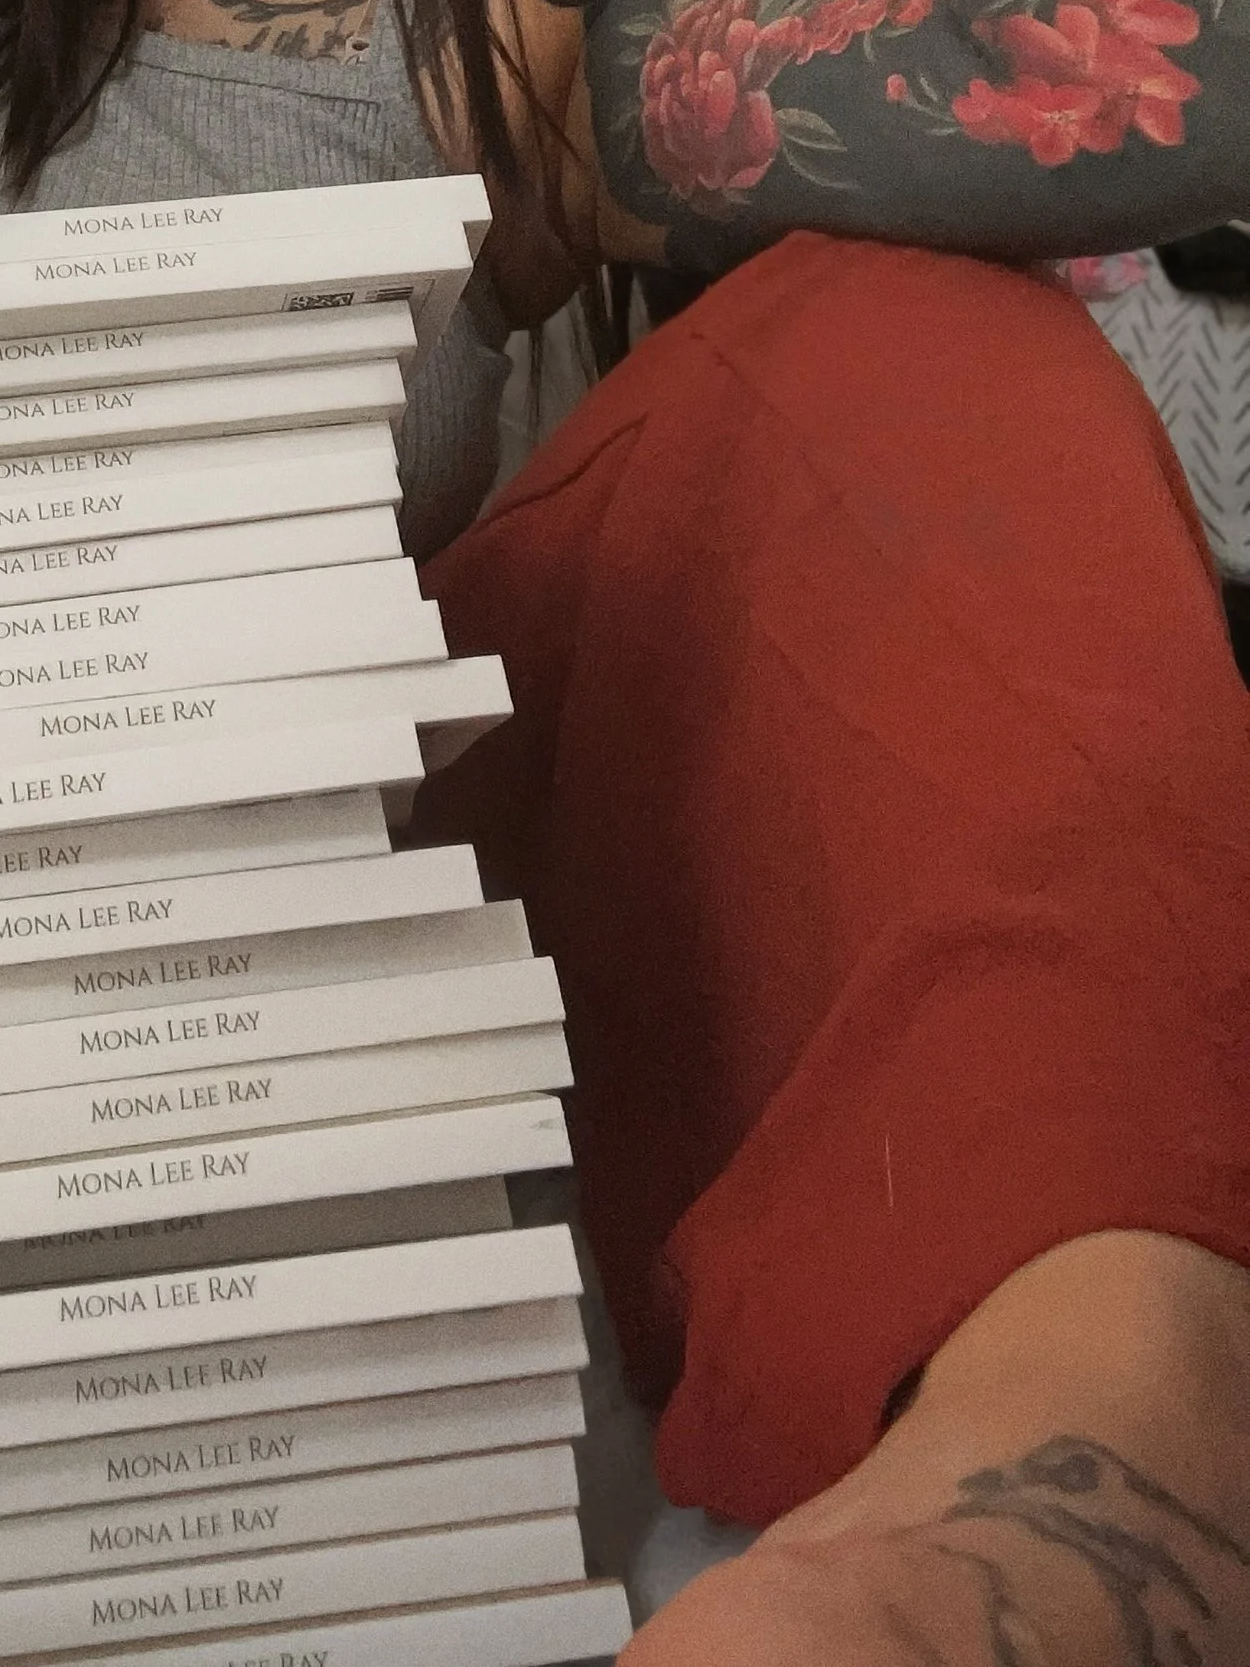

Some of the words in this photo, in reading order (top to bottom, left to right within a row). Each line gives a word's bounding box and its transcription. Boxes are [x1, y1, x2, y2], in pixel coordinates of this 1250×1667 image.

[65, 217, 134, 235] MONA
[141, 212, 177, 229] LEE
[184, 208, 222, 224] RAY
[36, 261, 106, 281] MONA
[113, 256, 150, 273] LEE
[157, 252, 196, 269] RAY
[62, 337, 98, 354] LEE
[105, 332, 143, 350] RAY
[52, 398, 88, 415] LEE
[95, 393, 134, 410] RAY
[51, 455, 86, 473] LEE
[94, 450, 133, 468] RAY
[38, 501, 75, 521] LEE
[82, 494, 122, 515] RAY
[31, 552, 70, 572] LEE
[77, 544, 118, 565] RAY
[53, 611, 91, 632] LEE
[98, 605, 139, 627] RAY
[59, 658, 98, 680] LEE
[105, 652, 148, 674] RAY
[41, 712, 118, 737] MONA
[125, 705, 165, 727] LEE
[173, 699, 215, 721] RAY
[12, 780, 52, 803] LEE
[61, 772, 105, 797] RAY
[38, 845, 82, 869] RAY
[79, 906, 119, 929] LEE
[127, 899, 172, 923] RAY
[75, 967, 153, 995] MONA
[160, 960, 201, 984] LEE
[208, 953, 251, 978] RAY
[81, 1025, 160, 1055] MONA
[167, 1018, 208, 1043] LEE
[215, 1011, 259, 1036] RAY
[92, 1094, 172, 1123] MONA
[179, 1085, 220, 1110] LEE
[227, 1078, 271, 1104] RAY
[58, 1168, 142, 1199] MONA
[150, 1160, 193, 1186] LEE
[202, 1152, 249, 1179] RAY
[61, 1291, 147, 1322] MONA
[155, 1282, 200, 1309] LEE
[209, 1275, 256, 1302] RAY
[76, 1373, 160, 1404] MONA
[167, 1364, 208, 1391] LEE
[220, 1355, 267, 1384] RAY
[107, 1451, 190, 1483] MONA
[198, 1441, 241, 1470] LEE
[249, 1435, 295, 1461] RAY
[89, 1521, 173, 1554] MONA
[181, 1513, 223, 1541] LEE
[232, 1505, 279, 1533] RAY
[93, 1593, 178, 1626] MONA
[185, 1586, 228, 1613] LEE
[236, 1578, 283, 1605] RAY
